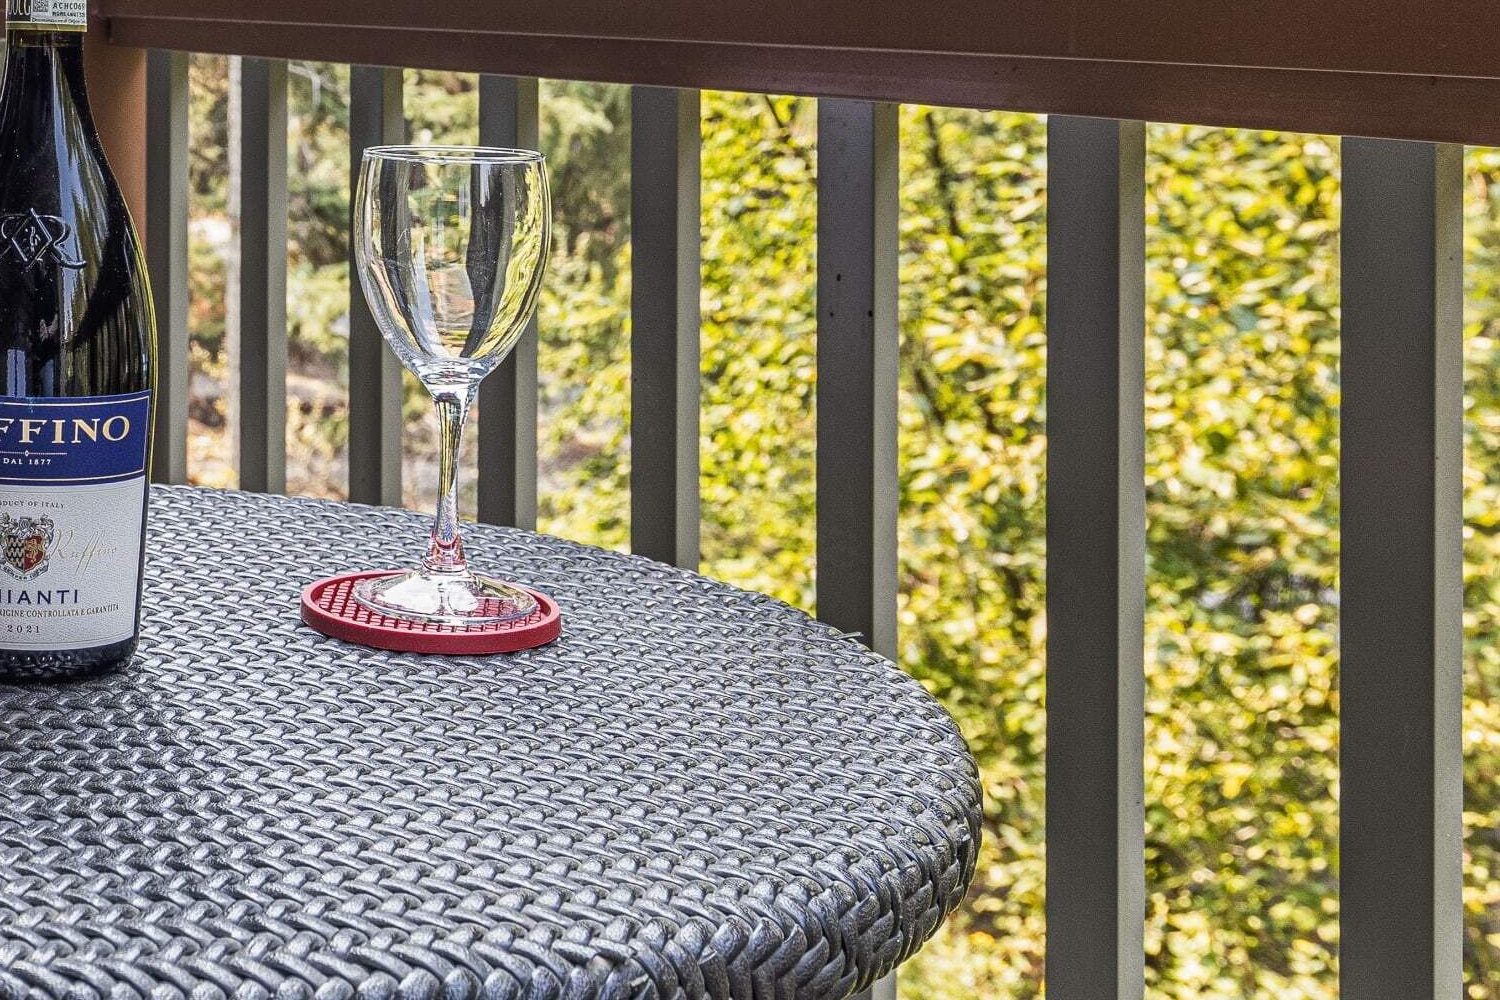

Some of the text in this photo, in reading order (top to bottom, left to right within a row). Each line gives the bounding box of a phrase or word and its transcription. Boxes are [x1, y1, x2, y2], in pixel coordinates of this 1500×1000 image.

[3, 457, 23, 465] DAL
[41, 501, 65, 509] ITALY
[26, 609, 79, 618] CONTROLLATA
[7, 624, 39, 634] 2021
